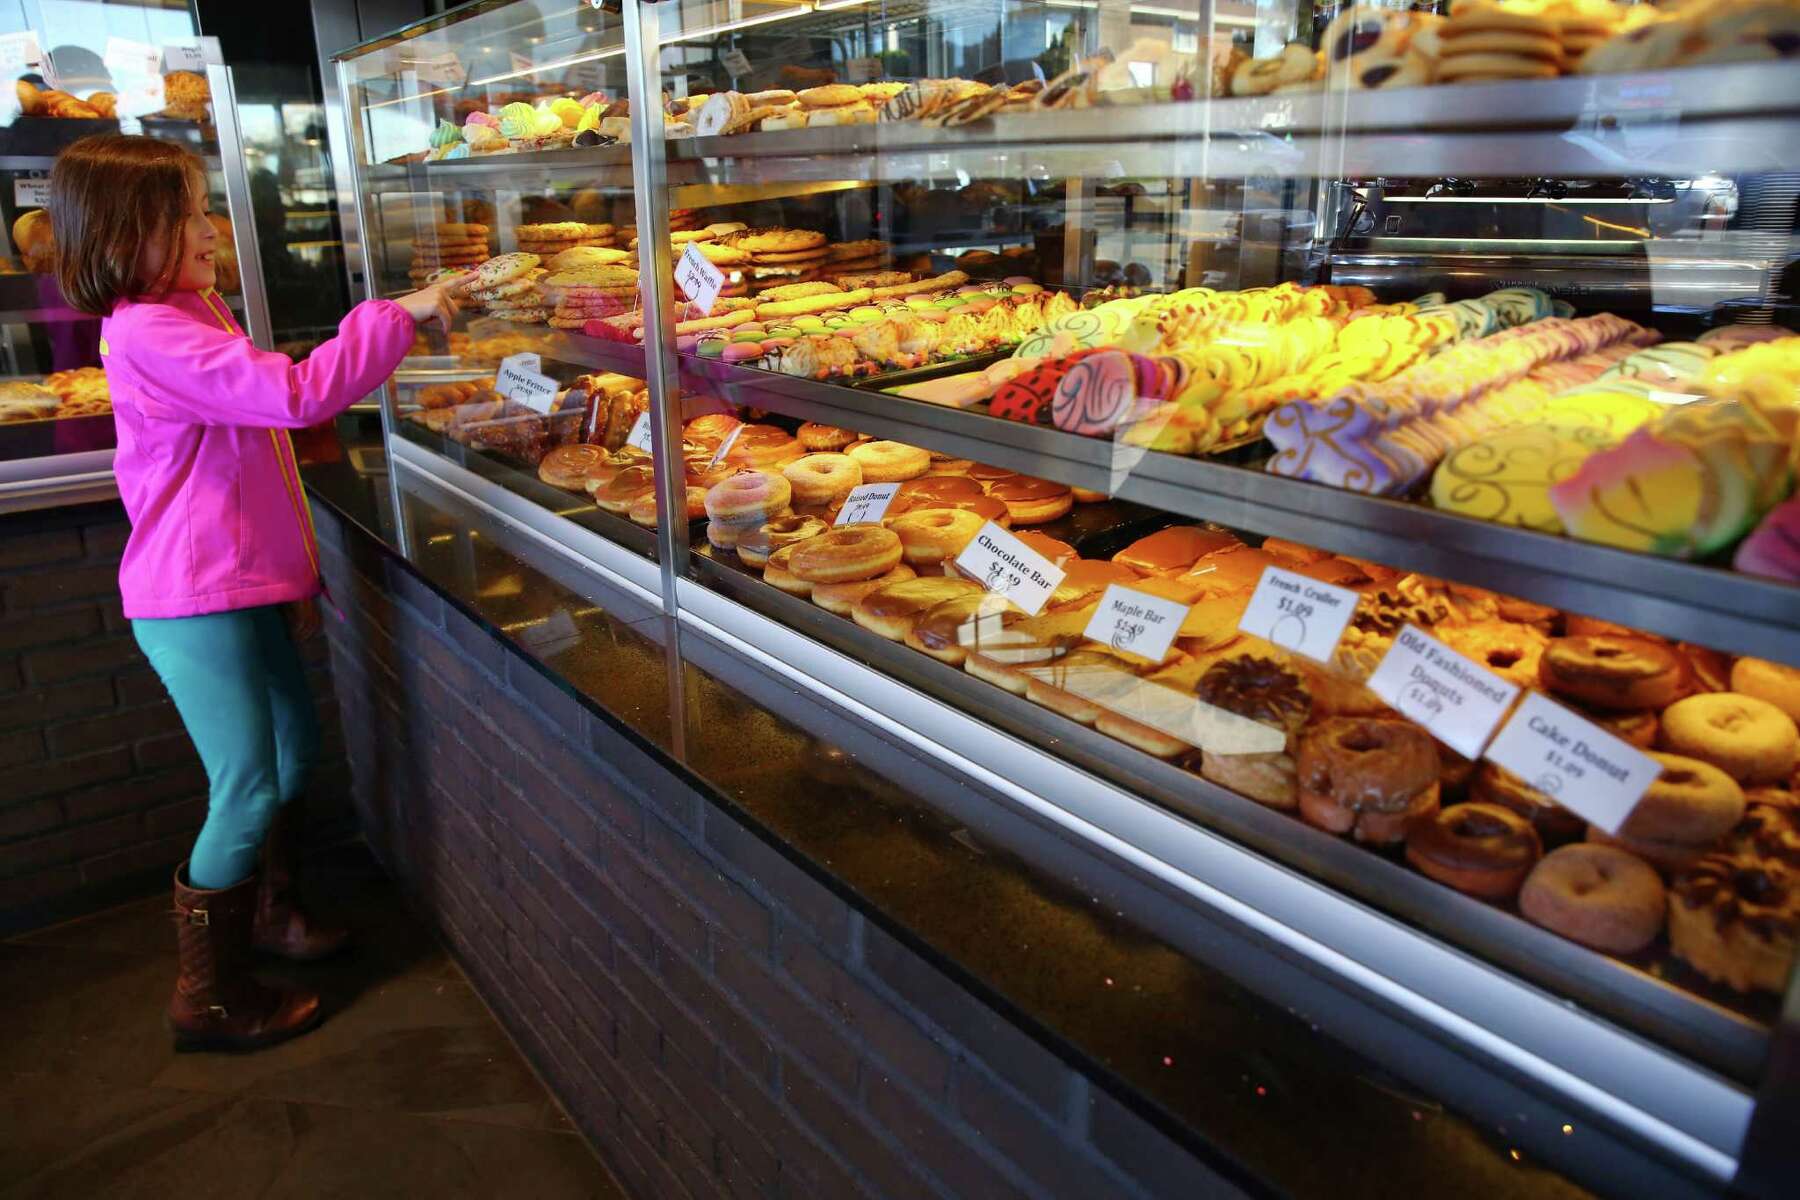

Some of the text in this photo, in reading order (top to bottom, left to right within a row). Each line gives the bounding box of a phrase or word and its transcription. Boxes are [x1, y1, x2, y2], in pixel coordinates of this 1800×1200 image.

[700, 267, 717, 290] Waffle
[503, 368, 552, 395] Apple Fritter
[868, 492, 891, 501] Donut
[977, 534, 1053, 590] Chocolate Bar
[1267, 576, 1342, 607] French Cruller
[1111, 600, 1166, 624] Maple Bar
[1399, 632, 1508, 704] Old Fashioned
[1527, 715, 1631, 784] Cake Donut
